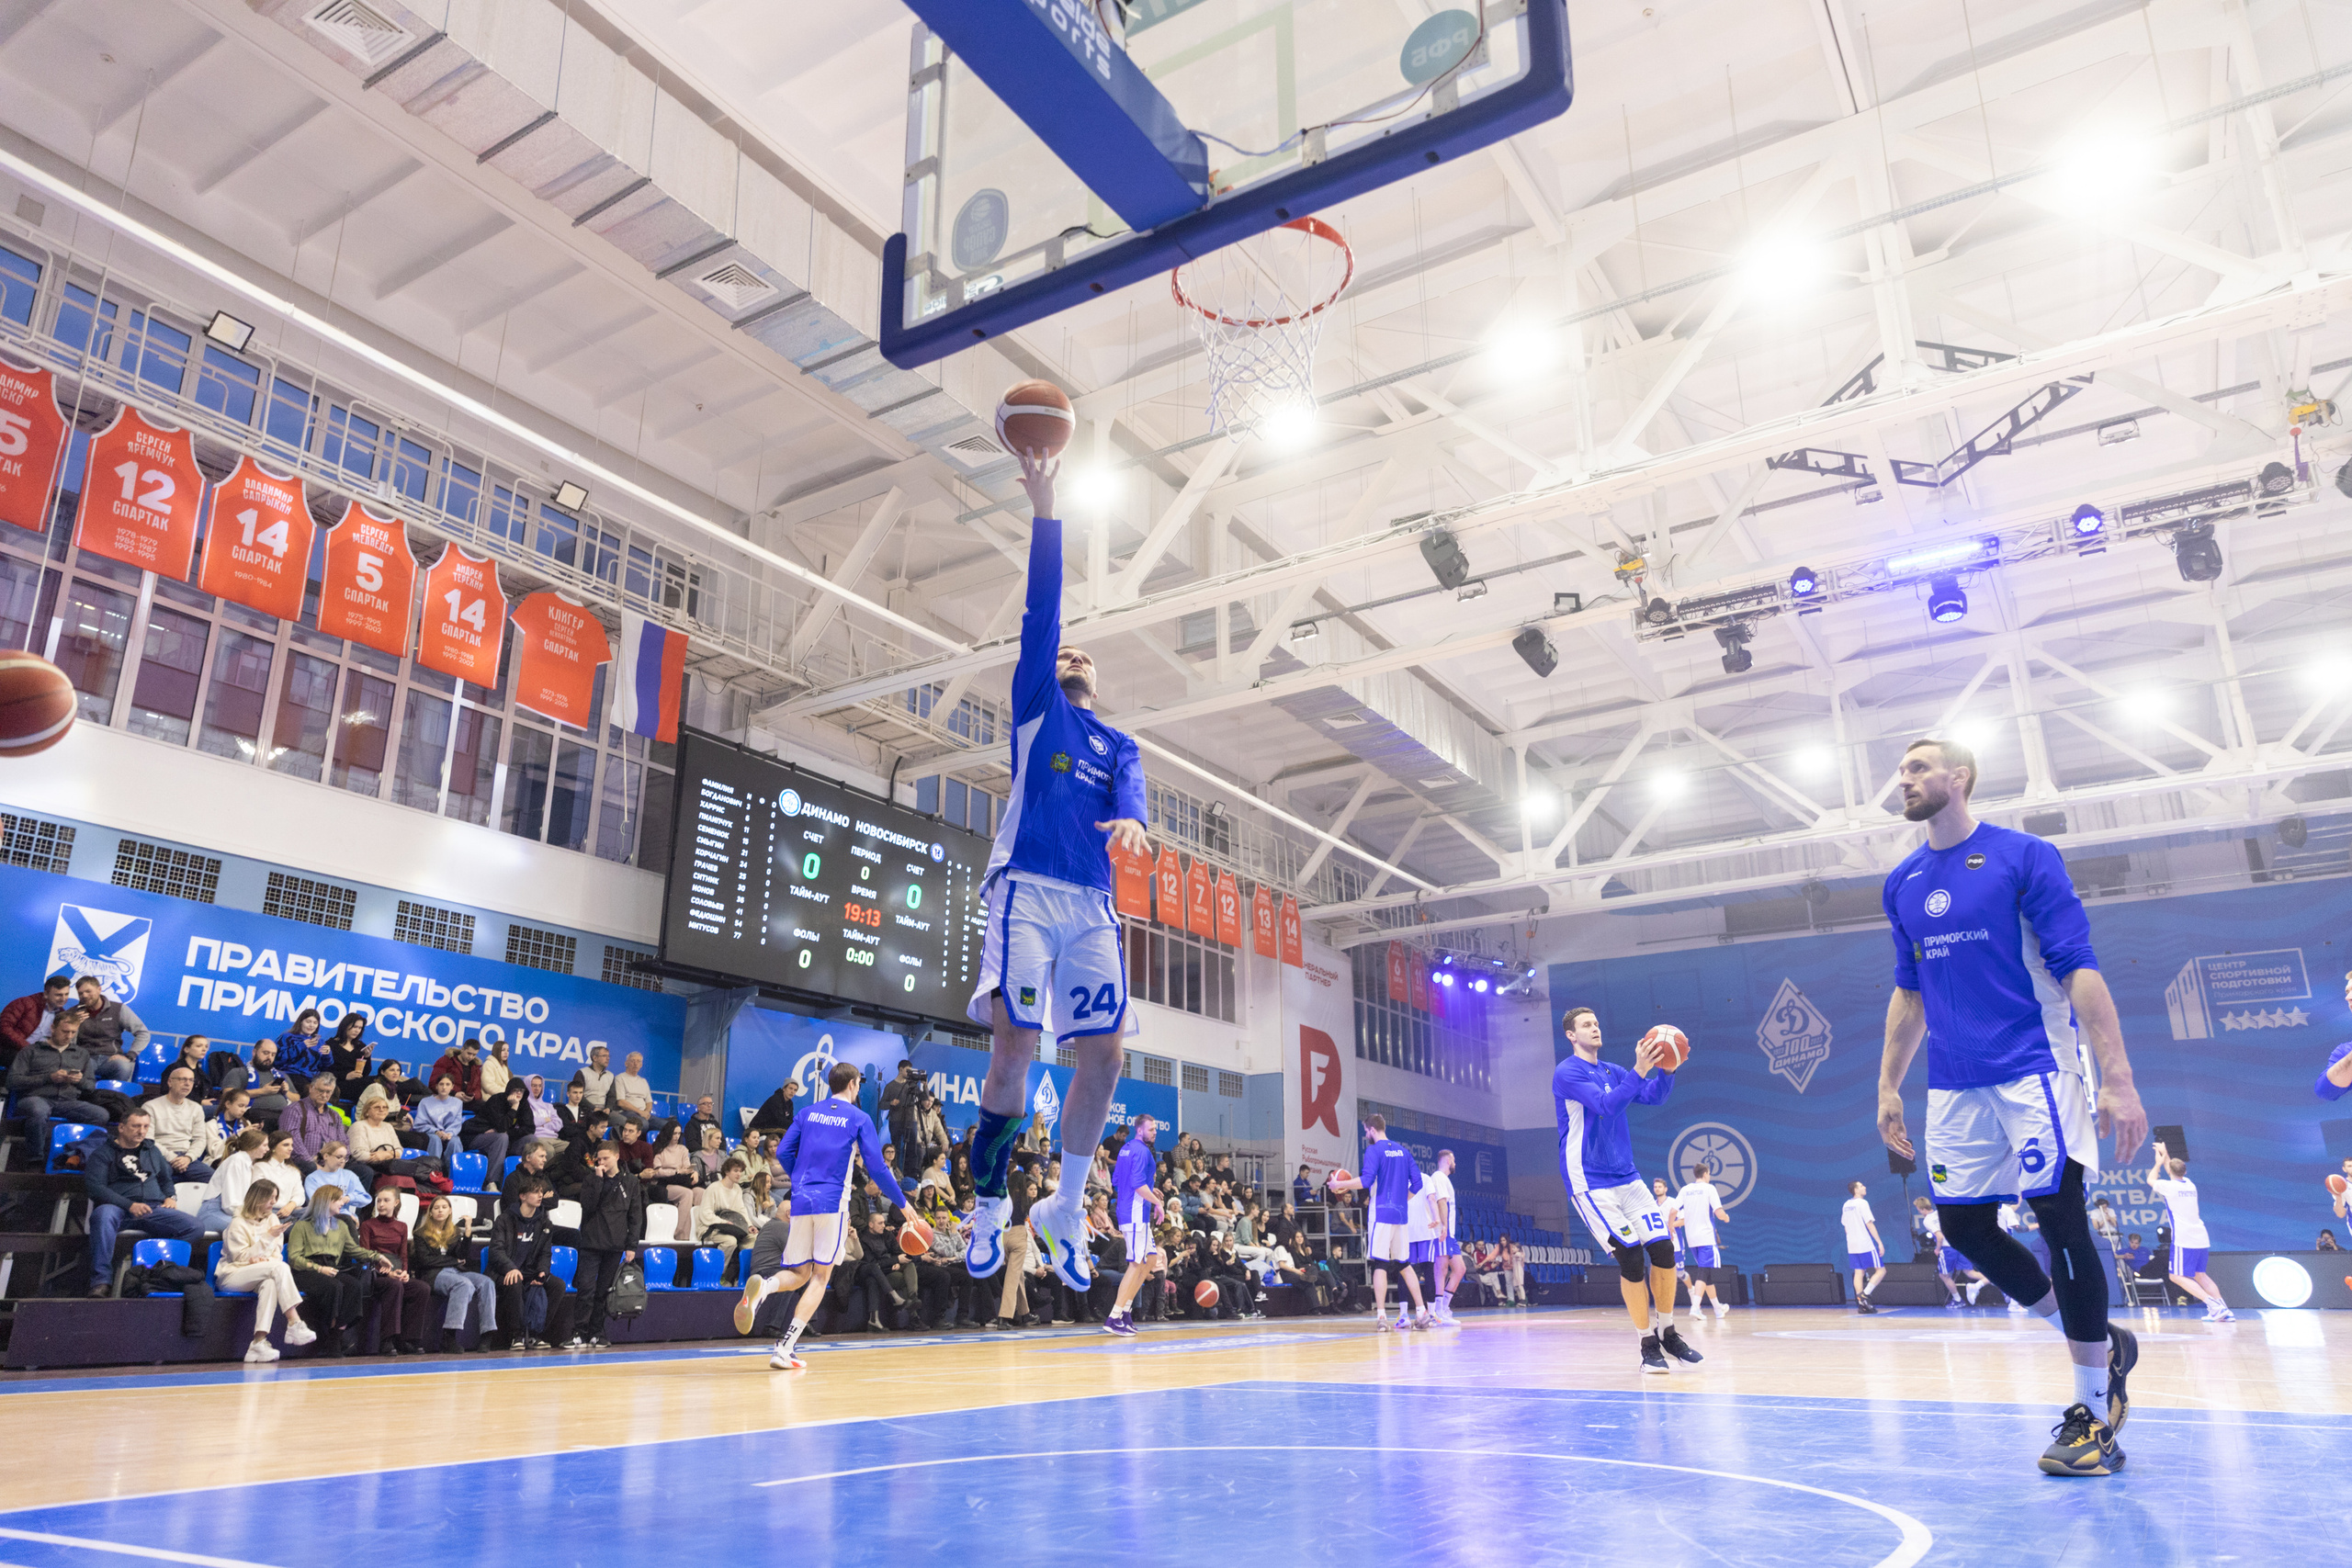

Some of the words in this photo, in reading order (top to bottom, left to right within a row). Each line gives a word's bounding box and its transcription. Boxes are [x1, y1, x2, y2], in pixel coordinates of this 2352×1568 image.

[0, 386, 24, 406] СКО
[136, 431, 172, 454] СЕРГЕЙ
[127, 441, 175, 468] ЯРЕМЧУК
[0, 456, 23, 477] АК
[114, 460, 176, 515] 12
[244, 478, 294, 503] ВЛАДИМИР
[243, 489, 292, 515] САПРЫКИН
[112, 501, 169, 532] СПАРТАК
[235, 508, 289, 558] 14
[360, 524, 390, 542] СЕРГЕЙ
[232, 545, 283, 575] СПАРТАК
[356, 551, 384, 592] 5
[456, 563, 483, 581] АНДРЕЙ
[345, 587, 390, 613] СПАРТАК
[444, 589, 486, 633] 14
[548, 605, 584, 630] КЛИГЕР
[441, 622, 482, 648] СПАРТАК
[544, 638, 580, 662] СПАРТАК
[701, 778, 734, 795] ФАМИЛИЯ
[699, 800, 726, 814] ХАРРИС
[700, 788, 743, 807] БОГДАНОВИЧ
[698, 811, 733, 829] ПИЛИПЧУК
[800, 802, 851, 828] ДИНАМО
[855, 819, 929, 855] НОВОСИБИРСК
[697, 824, 729, 840] СЕМЕНЮК
[803, 830, 825, 844] СЧЕТ
[696, 836, 725, 850] СМЫГИН
[695, 847, 729, 863] КОРЧАГИН
[851, 845, 882, 864] ПЕРИОД
[694, 859, 718, 873] ГРАЧЕВ
[802, 852, 821, 880] 0
[861, 865, 870, 881] 0
[906, 863, 925, 876] СЧЕТ
[692, 884, 715, 897] ИОНОВ
[693, 872, 720, 886] СИТНИК
[738, 884, 746, 892] 30
[1161, 872, 1178, 896] 12
[789, 885, 830, 905] ТАЙМ-АУТ
[851, 885, 877, 900] ВРЕМЯ
[906, 883, 922, 910] 0
[1196, 884, 1204, 904] 7
[690, 896, 725, 911] СОЛОВЬЕВ
[1221, 894, 1236, 918] 12
[689, 908, 726, 924] ФЕДЮШИН
[843, 901, 882, 929] 19:13
[895, 914, 931, 932] ТАЙМ-АУТ
[1258, 908, 1272, 929] 13
[688, 920, 719, 934] МИТУСОВ
[793, 928, 820, 943] ФОЛЫ
[842, 928, 881, 946] ТАЙМ-АУТ
[1284, 917, 1298, 939] 14
[1924, 929, 1989, 947] ПРИМОРСКИЙ
[798, 949, 812, 969] 0
[845, 946, 875, 967] 0:00
[899, 953, 922, 968] ФОЛЫ
[1925, 944, 1951, 960] КРАЙ
[1395, 959, 1400, 976] 6
[2208, 961, 2247, 971] ЦЕНТР
[2210, 964, 2291, 980] СПОРТИВНОЙ
[185, 935, 549, 1024] ПРАВИТЕЛЬСТВО
[903, 973, 915, 993] 0
[1416, 968, 1422, 987] 11
[2211, 976, 2292, 989] ПОДГОТОВКИ
[1069, 982, 1118, 1021] 24
[177, 975, 505, 1052] ПРИМОРСКОГО
[514, 1028, 608, 1065] КРАЯ
[1784, 1034, 1811, 1057] 100
[1774, 1047, 1824, 1067] ДИНАМО
[808, 1111, 849, 1128] ПИЛИПЧУК
[1641, 1212, 1665, 1232] 15
